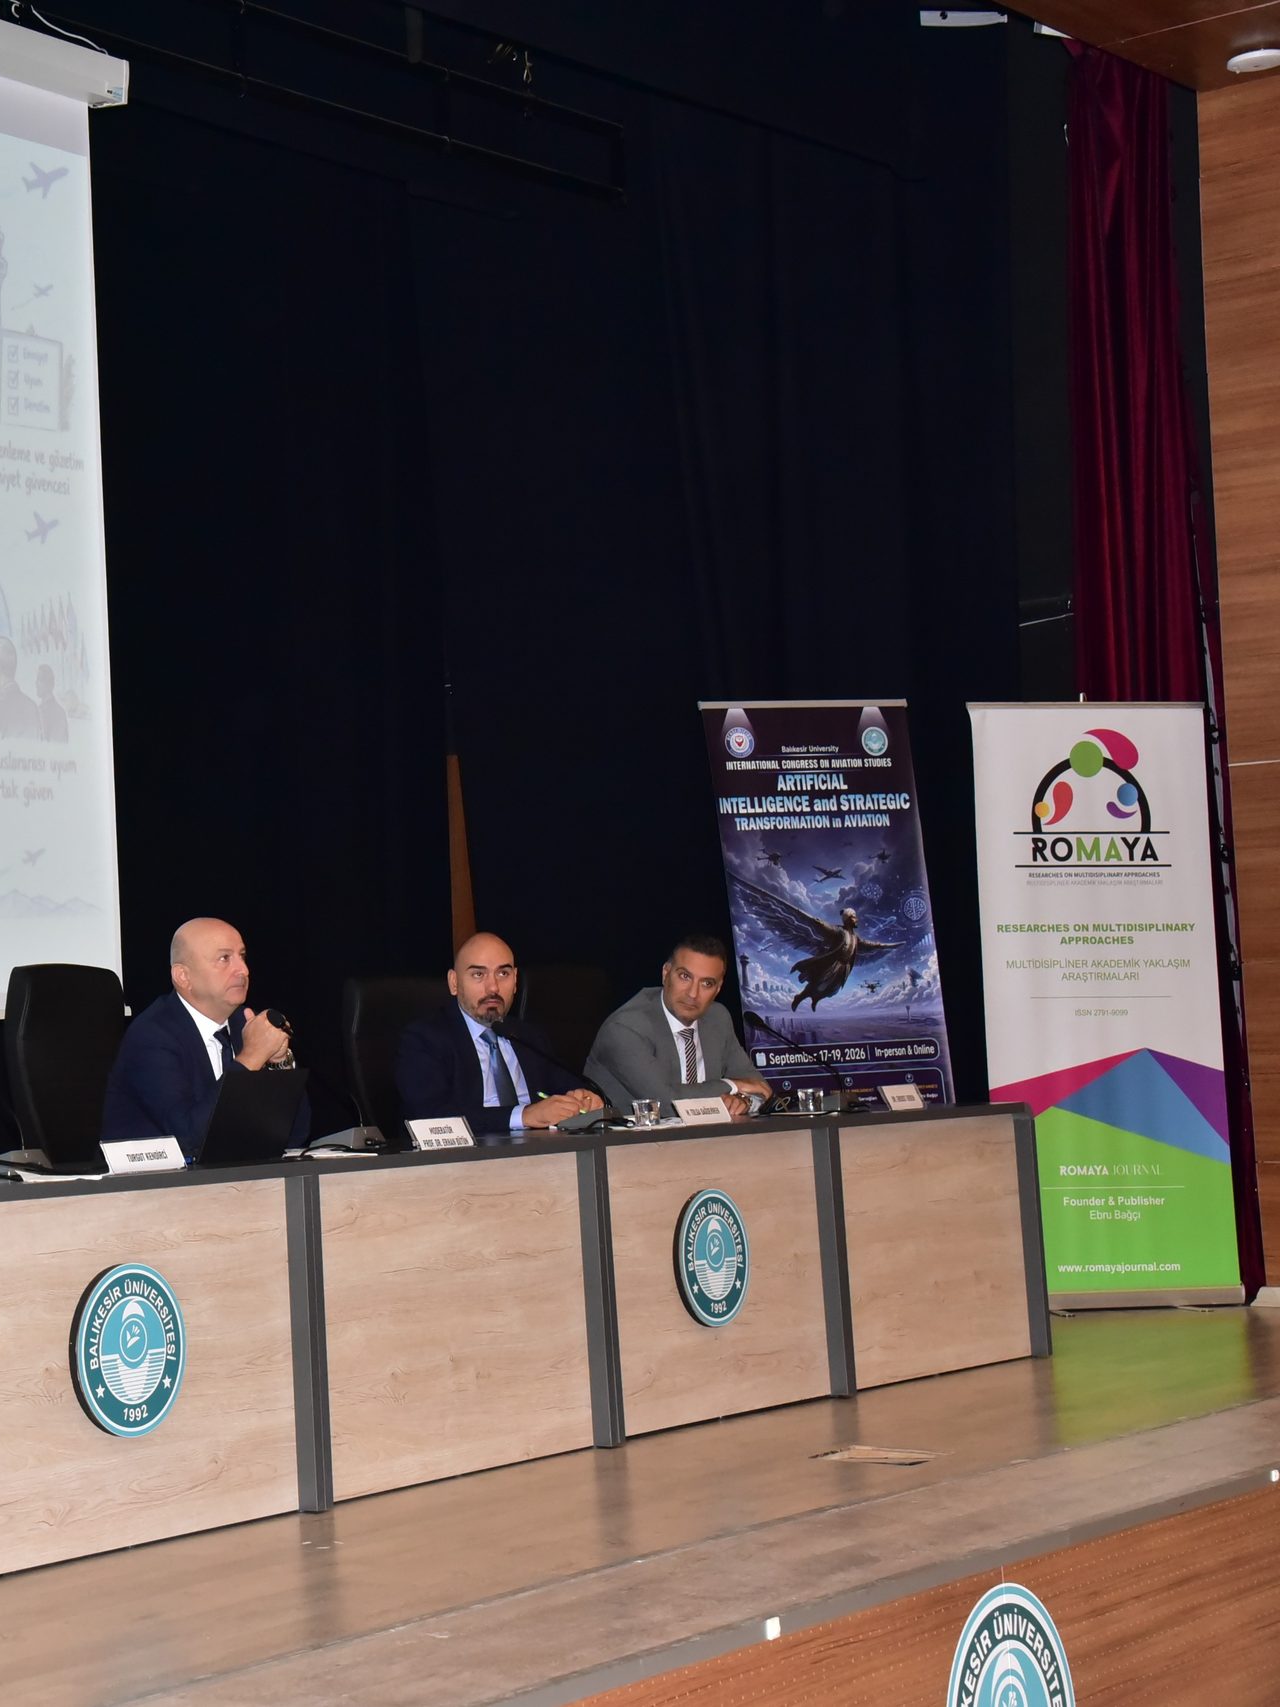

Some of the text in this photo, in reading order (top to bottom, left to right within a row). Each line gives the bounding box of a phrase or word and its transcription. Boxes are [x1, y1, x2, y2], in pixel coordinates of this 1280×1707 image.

[726, 757, 892, 771] INTERNATIONAL CONGRESS ON AVIATION STUDIES
[777, 774, 848, 791] ARTIFICIAL
[720, 793, 910, 815] INTELLIGENCE and STRATEGIC
[735, 813, 890, 831] TRANSFORMATION in AVIATION
[1031, 836, 1159, 862] ROMAYA
[997, 923, 1195, 933] RESEARCHES ON MULTIDISIPLINARY
[1060, 936, 1134, 945] APPROACHES
[1090, 957, 1141, 968] AKADEMİK
[1061, 972, 1139, 983] ARAŞTIRMALARI
[820, 1049, 844, 1062] 17-19,
[844, 1048, 866, 1060] 2026
[875, 1044, 935, 1058] In-person & Online
[1060, 1164, 1163, 1176] ROMAYA JOURNAL
[1063, 1196, 1165, 1206] Founder & Publisher
[1089, 1210, 1141, 1222] Ebru Bağçı
[687, 1206, 707, 1272] BALIKESİR
[1058, 1262, 1181, 1274] www.romayajournal.com
[710, 1301, 728, 1314] 1992
[90, 1286, 122, 1370] BALIKESİR
[123, 1404, 149, 1422] 1992
[961, 1608, 1064, 1707] KESİR ÜNİVERSİTE
